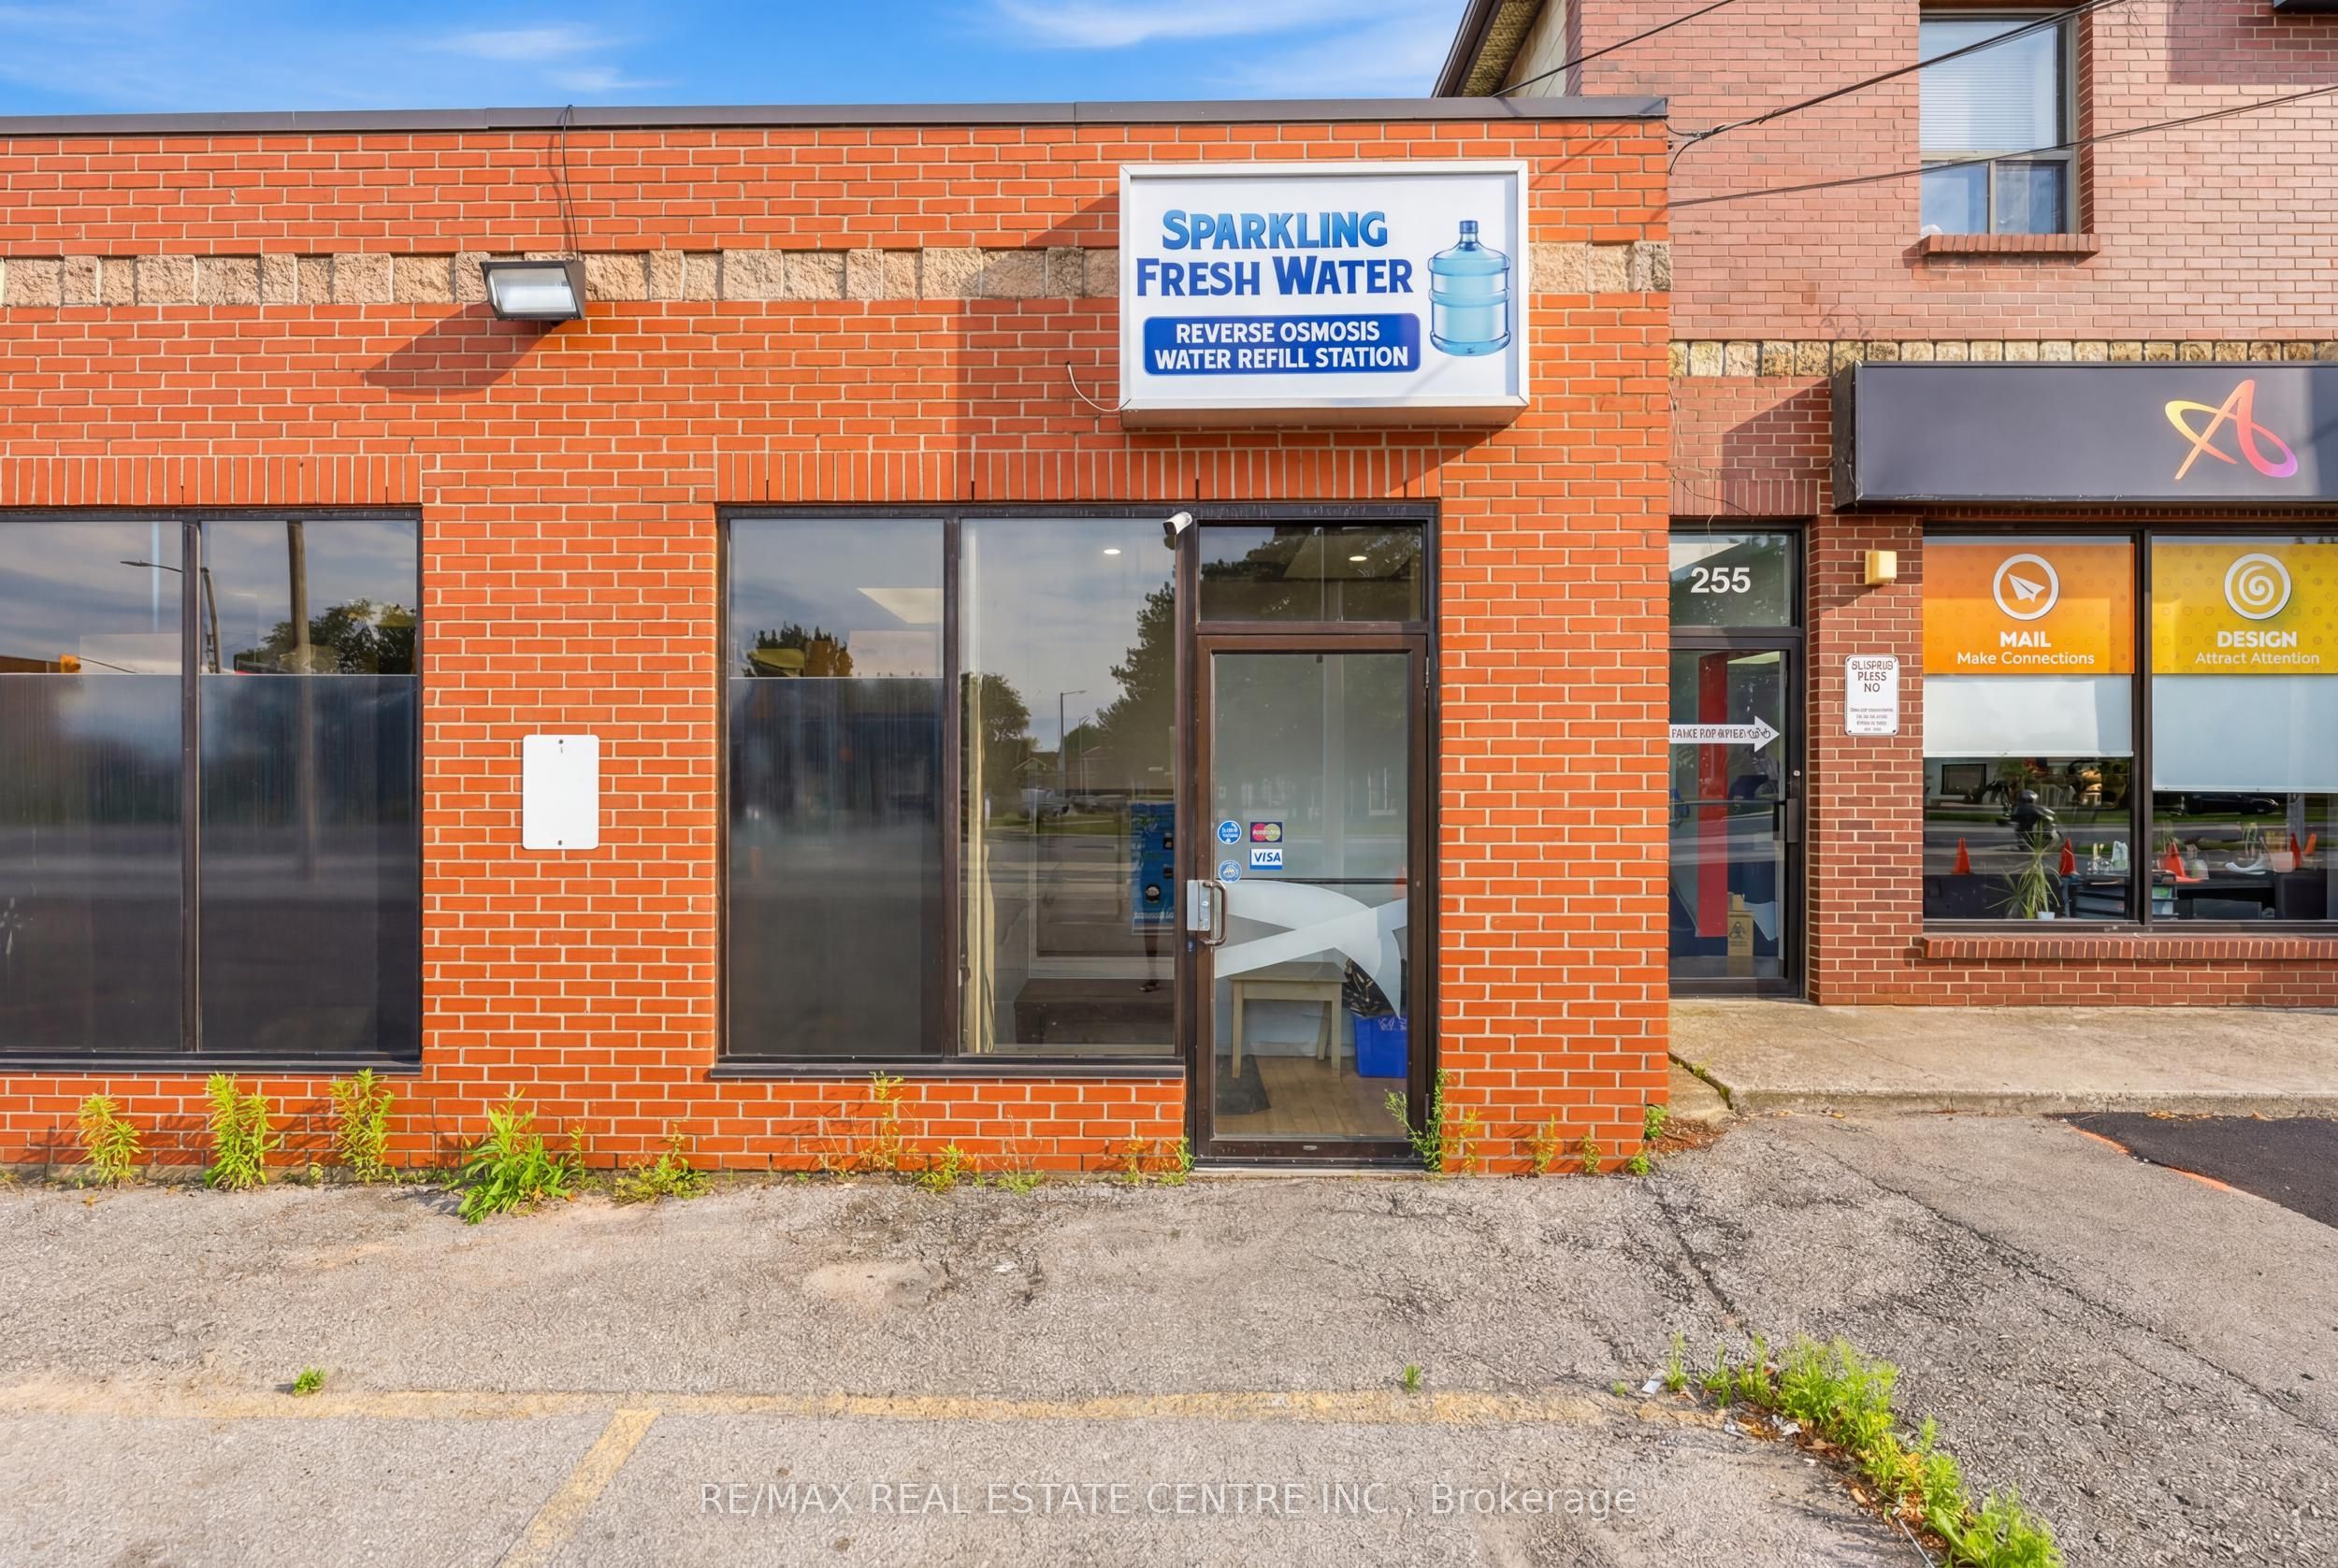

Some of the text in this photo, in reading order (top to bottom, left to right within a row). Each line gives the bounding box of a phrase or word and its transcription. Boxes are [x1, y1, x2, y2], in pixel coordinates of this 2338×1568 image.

[1162, 209, 1388, 251] SPARKLING
[1136, 255, 1414, 296] FRESH WATER
[1176, 320, 1380, 344] REVERSE OSMOSIS
[1154, 346, 1408, 370] WATER REFILL STATION
[1690, 567, 1752, 594] 255
[1999, 631, 2052, 648] MAIL
[2216, 630, 2298, 648] DESIGN
[1956, 652, 2095, 666] Make Connections
[2195, 652, 2320, 666] Attract Attention
[1864, 683, 1881, 693] NO
[1254, 852, 1281, 862] VISA
